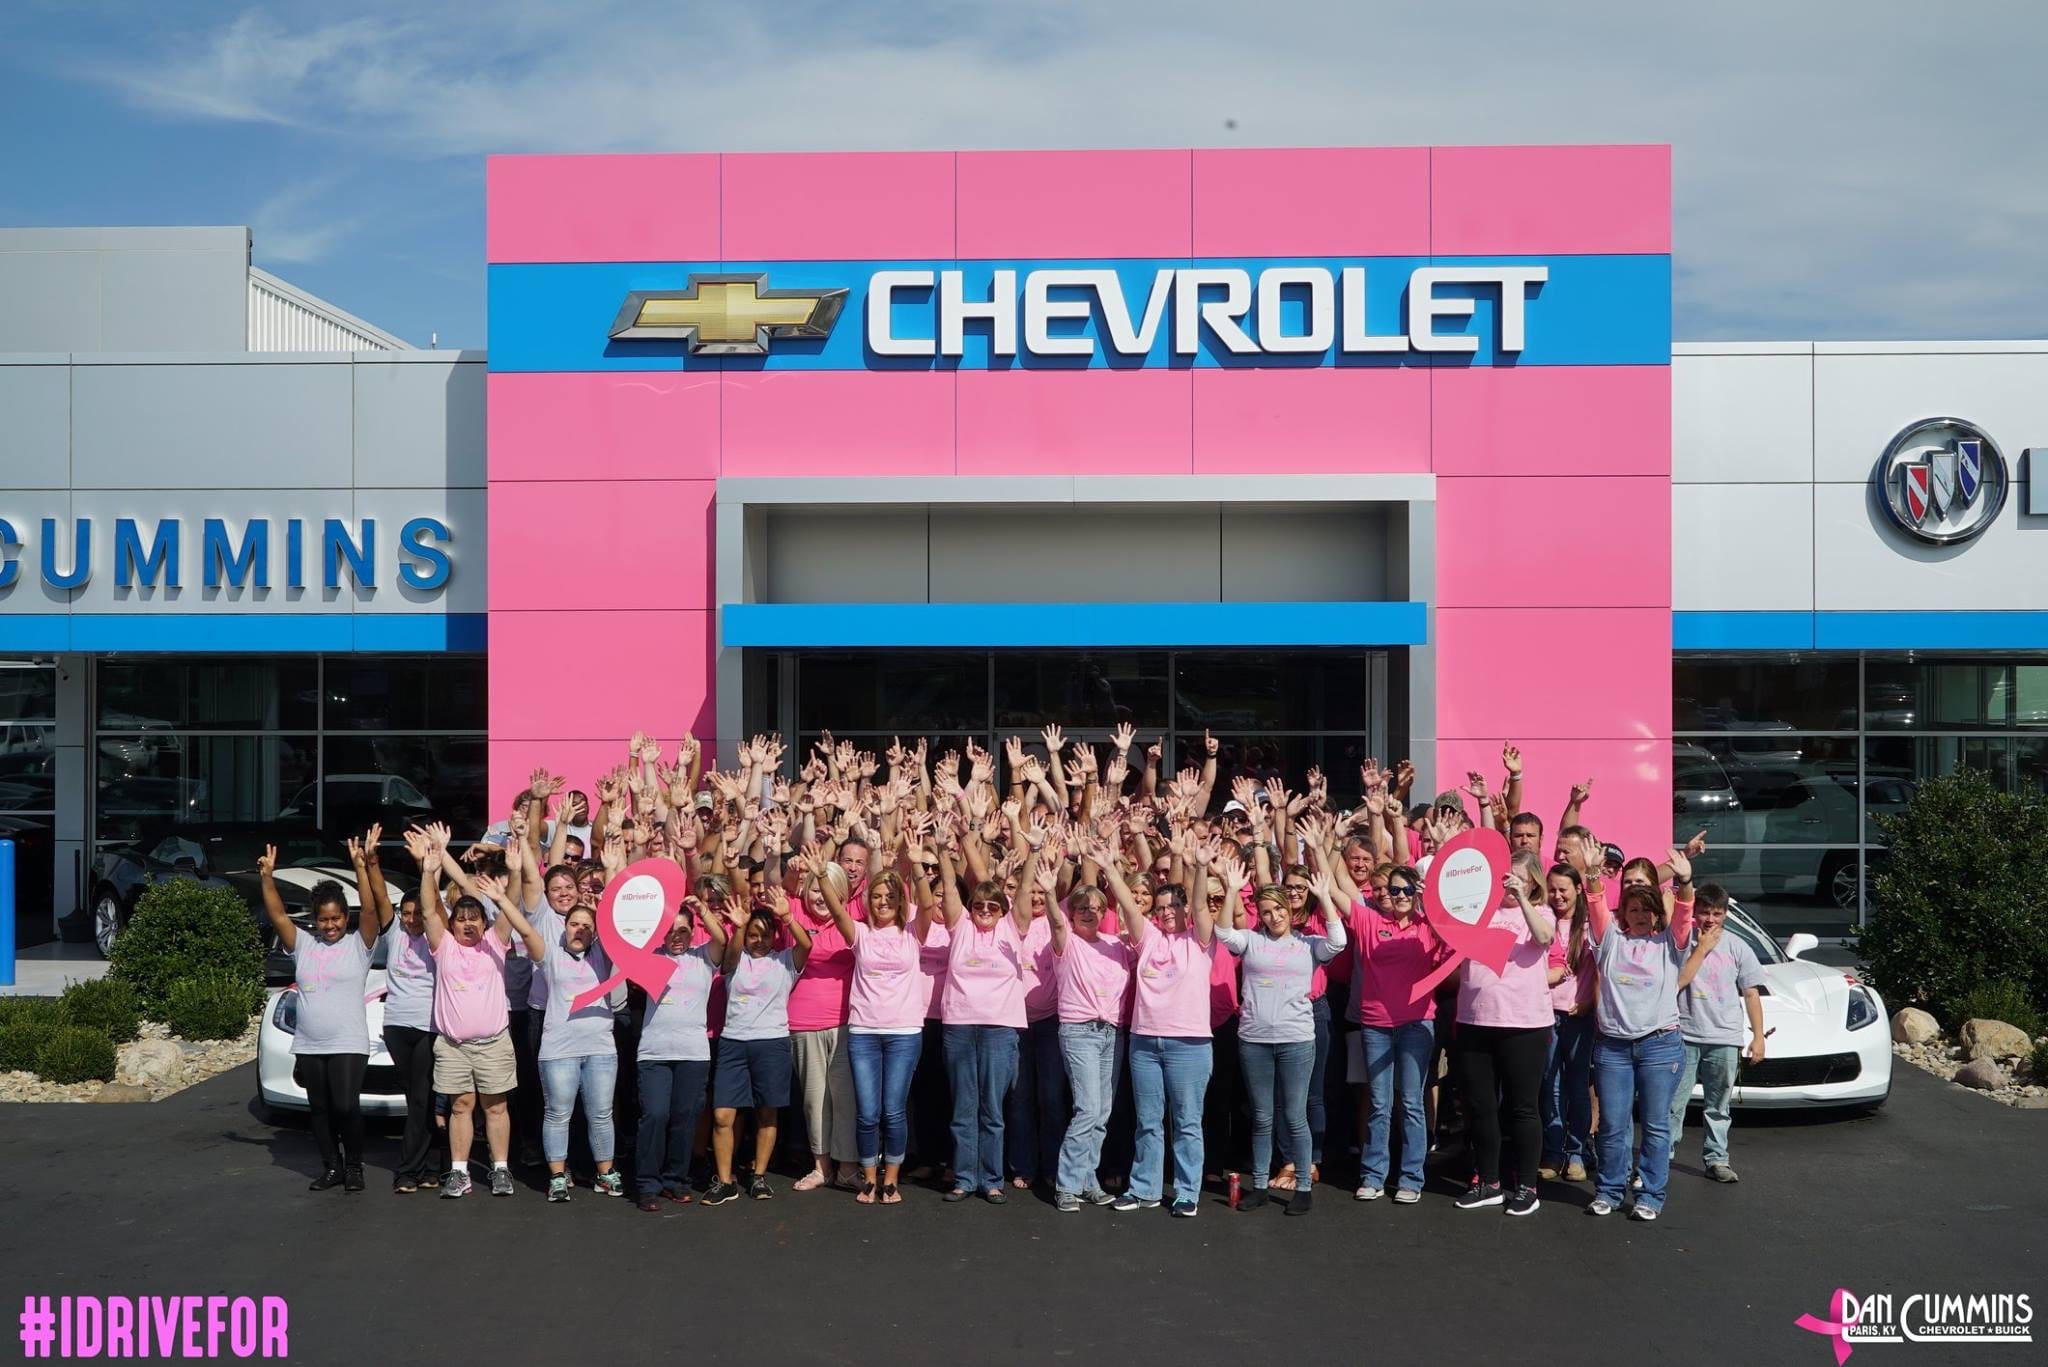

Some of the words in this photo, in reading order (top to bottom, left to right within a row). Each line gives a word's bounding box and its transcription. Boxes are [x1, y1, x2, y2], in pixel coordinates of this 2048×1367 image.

[867, 266, 1549, 356] CHEVROLET
[1445, 864, 1483, 878] #IDriveFor
[621, 892, 658, 901] #IDriveFor
